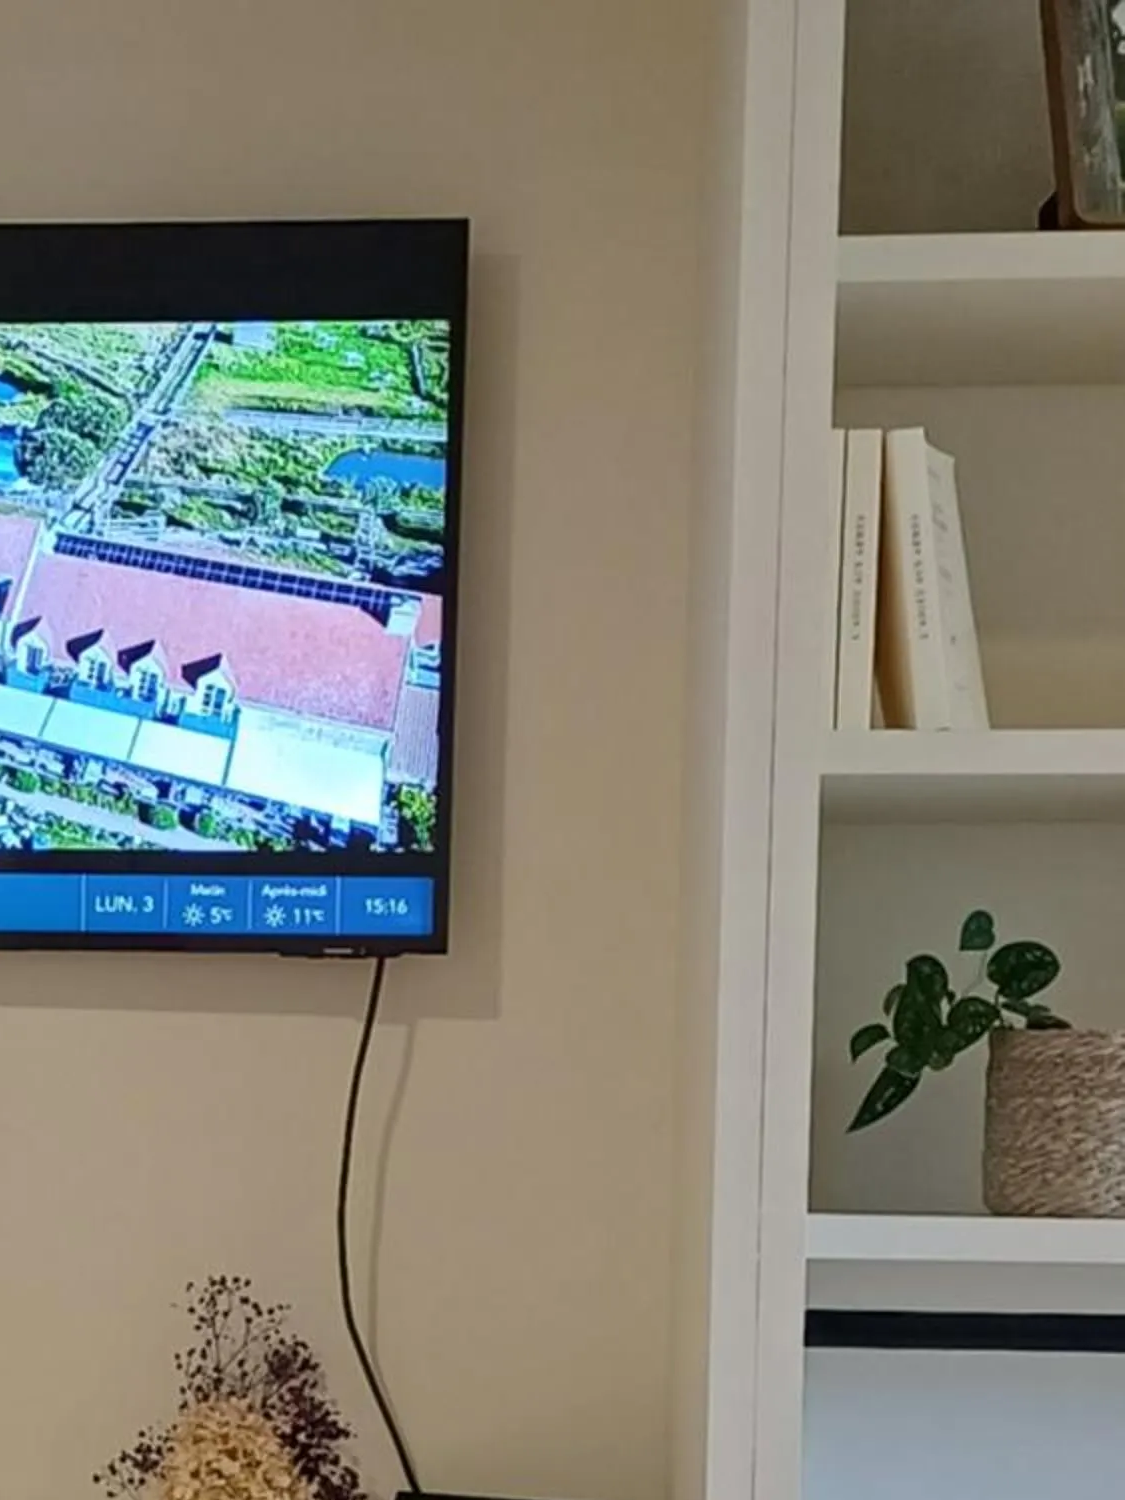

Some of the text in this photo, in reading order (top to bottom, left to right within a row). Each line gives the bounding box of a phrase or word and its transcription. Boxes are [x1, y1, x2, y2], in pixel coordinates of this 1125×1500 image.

[95, 895, 155, 913] LUN. 3
[365, 897, 409, 915] 15:16
